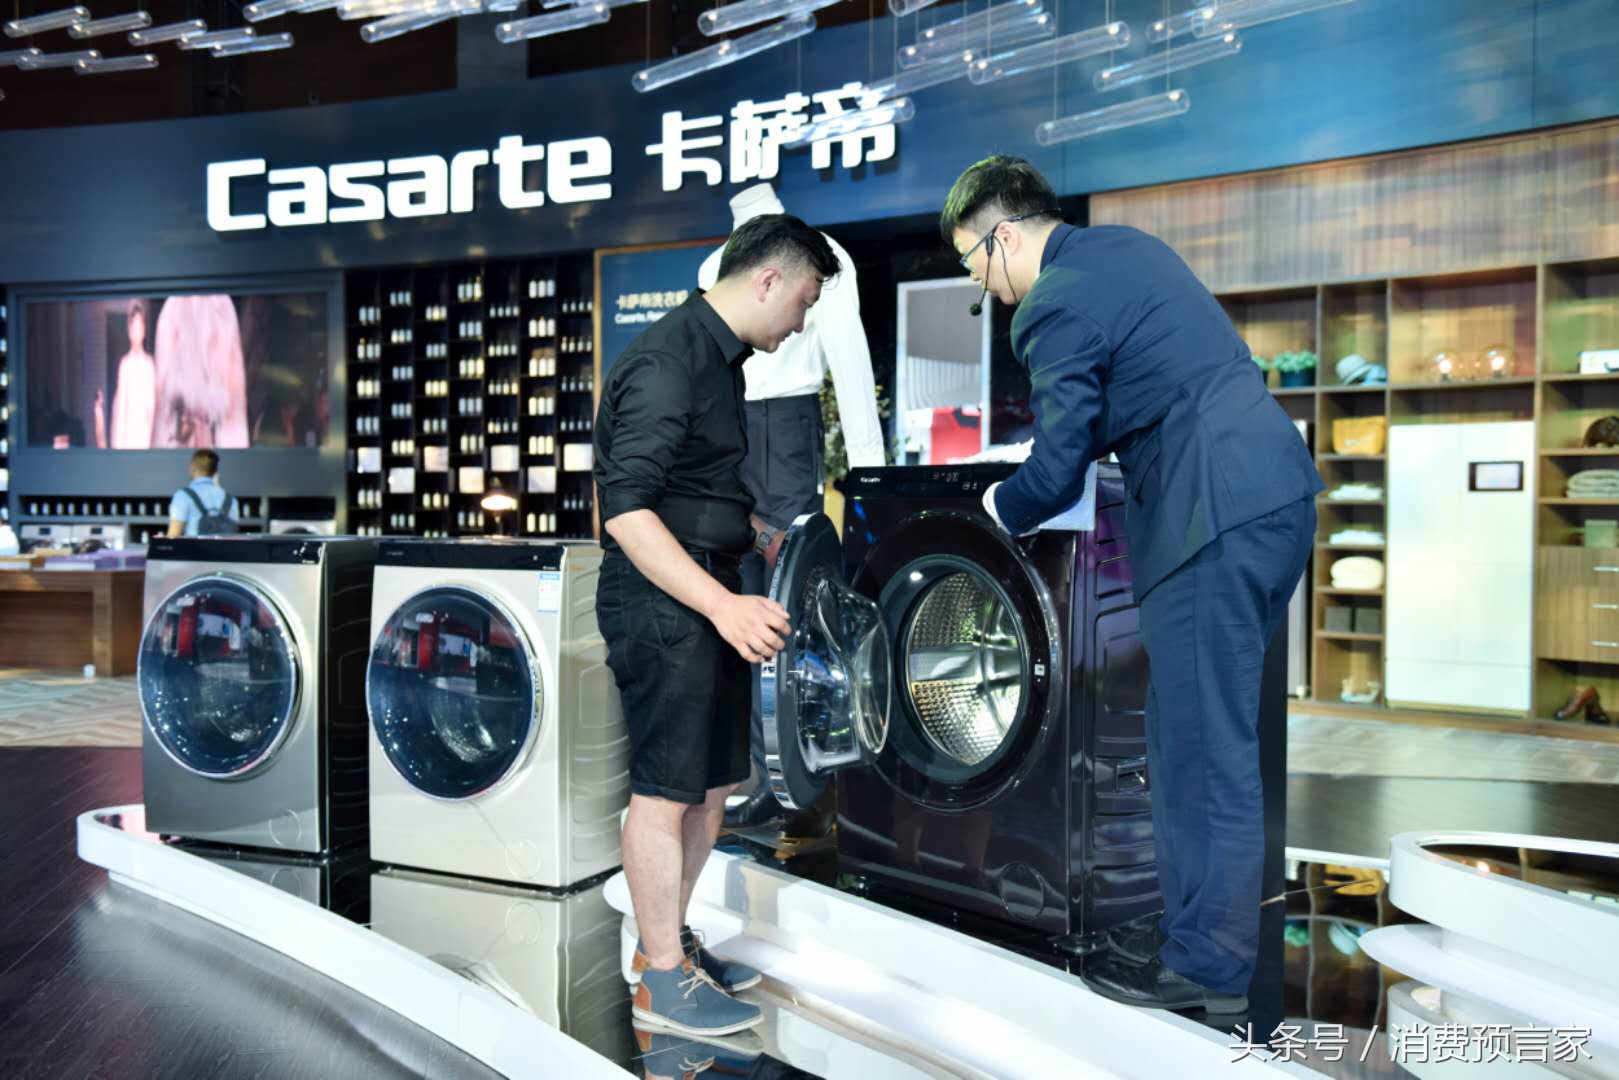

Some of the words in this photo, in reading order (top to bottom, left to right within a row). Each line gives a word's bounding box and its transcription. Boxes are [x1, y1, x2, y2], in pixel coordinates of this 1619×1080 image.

[206, 135, 612, 232] Casarte
[645, 82, 897, 191] 卡萨帝
